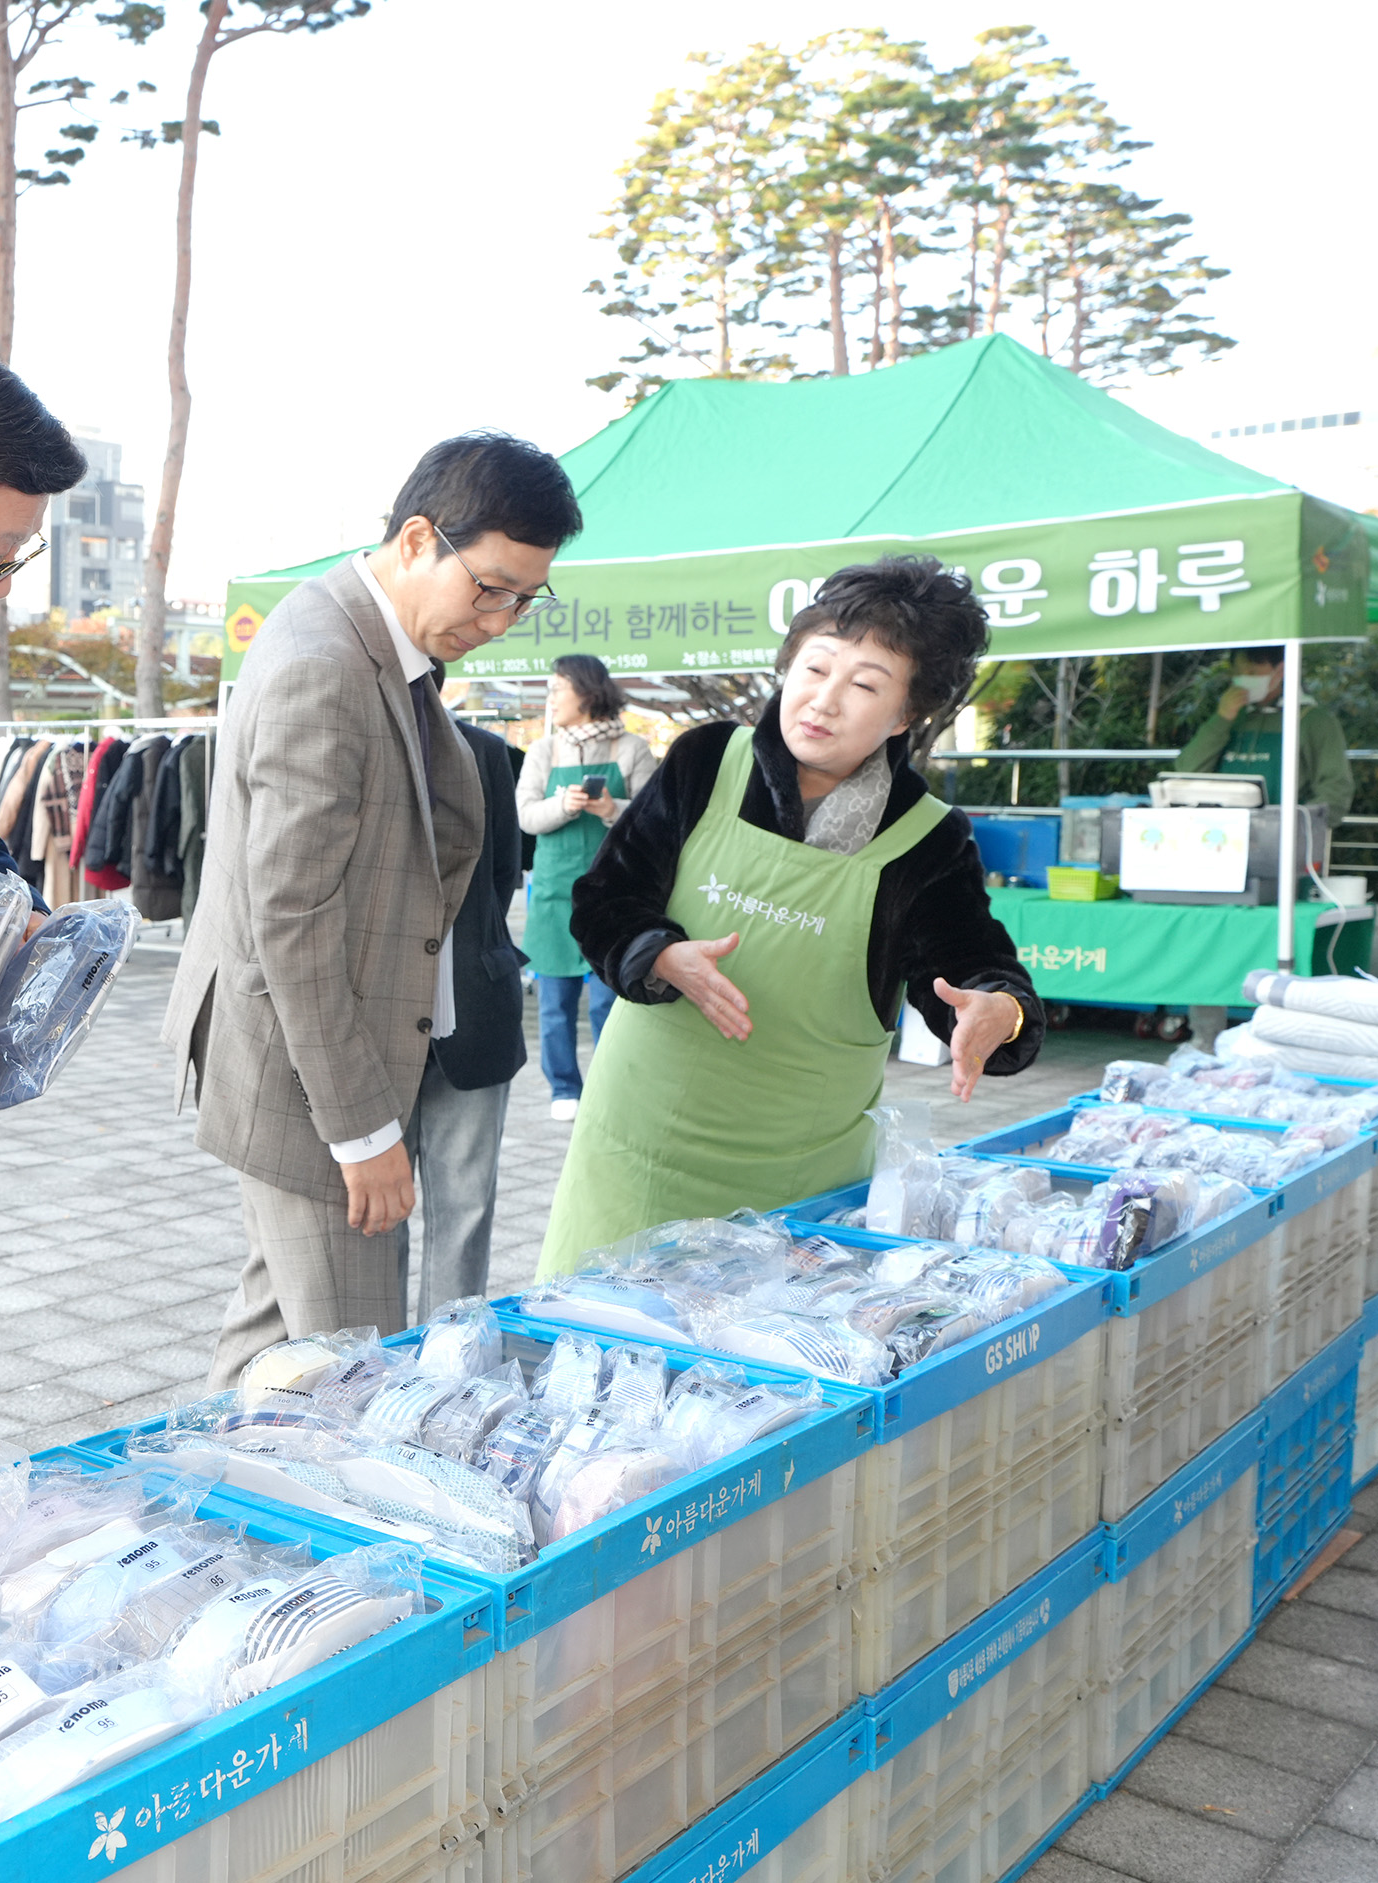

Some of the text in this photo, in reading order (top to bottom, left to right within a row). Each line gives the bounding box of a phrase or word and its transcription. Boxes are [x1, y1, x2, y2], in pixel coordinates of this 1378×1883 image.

[626, 600, 756, 640] 함께하는
[1088, 539, 1251, 616] 하루
[726, 891, 826, 936] 아름다운가게
[81, 951, 110, 990] renoma
[101, 971, 115, 986] 105
[340, 1359, 366, 1384] renoma
[985, 1341, 1003, 1375] GS
[264, 1387, 314, 1399] renoma
[396, 1447, 416, 1461] 100
[666, 1469, 761, 1540] 아름다운가게
[116, 1541, 159, 1568] renoma
[144, 1559, 160, 1570] 95
[182, 1553, 224, 1580] renoma
[210, 1574, 225, 1588] 95
[229, 1586, 272, 1604] renoma
[271, 1589, 316, 1618] renoma
[300, 1608, 316, 1619] 95
[58, 1697, 109, 1734] renoma
[97, 1716, 115, 1730] 95
[134, 1717, 309, 1834] 아름다운가게
